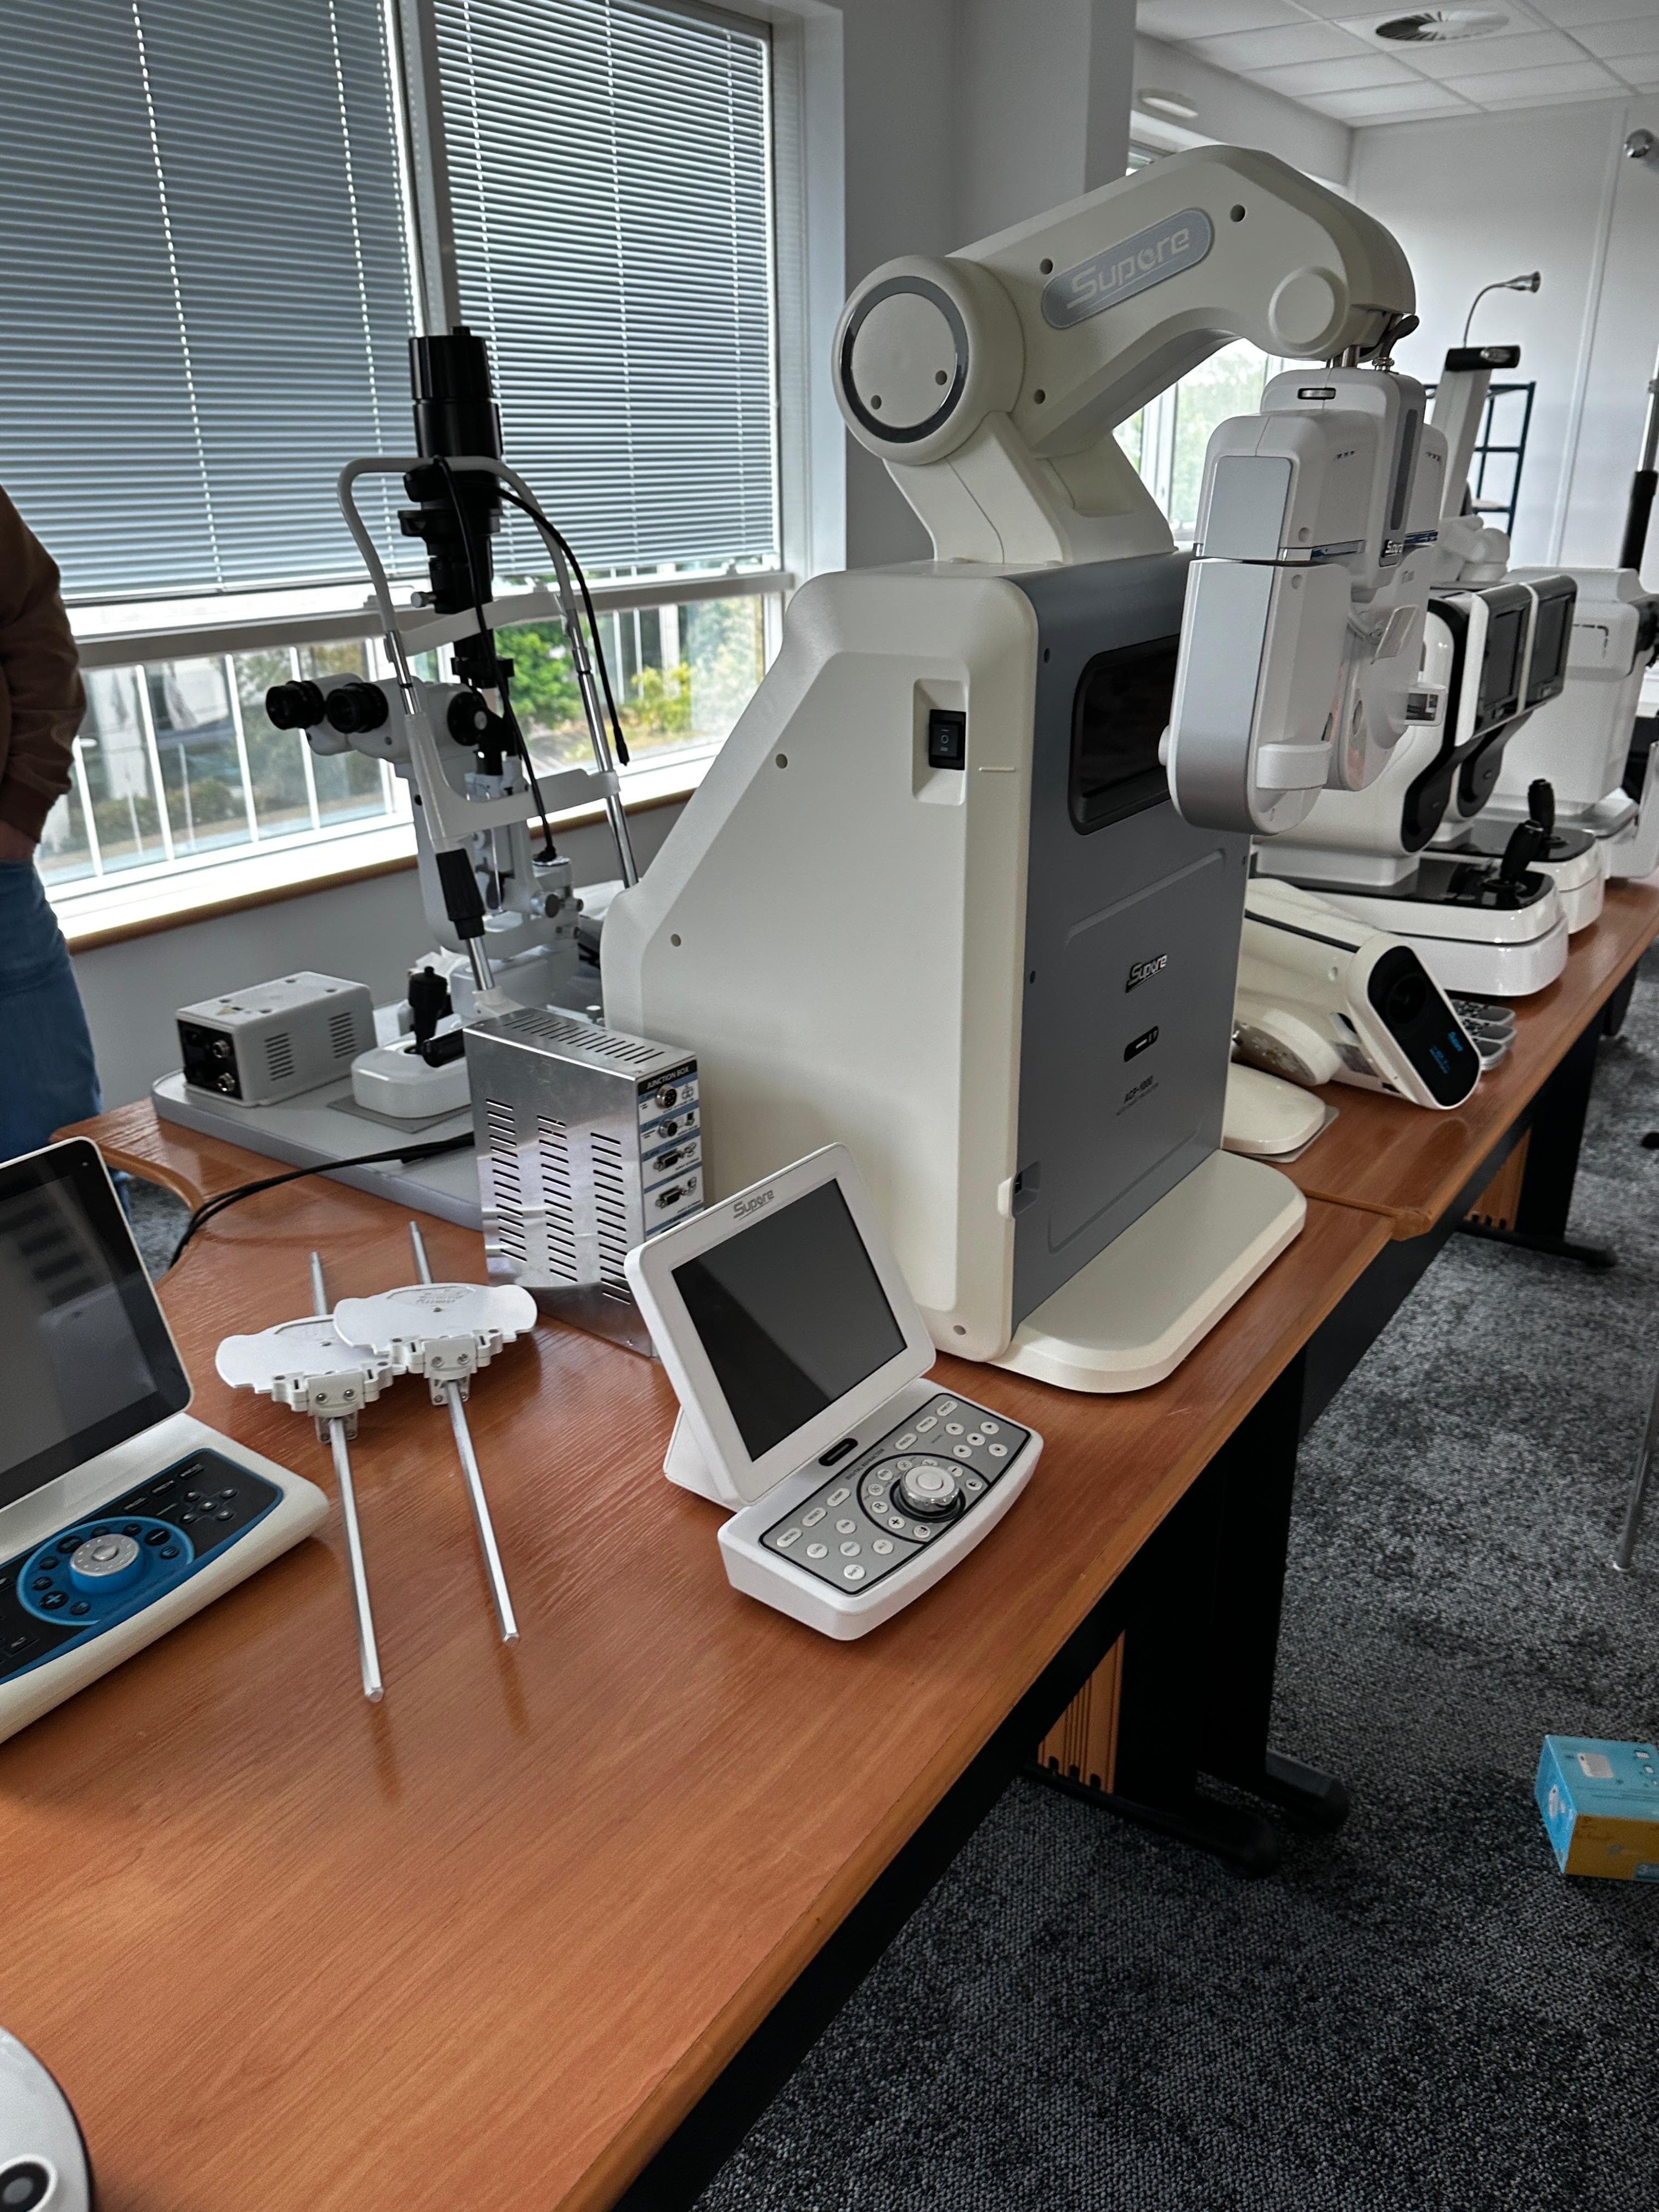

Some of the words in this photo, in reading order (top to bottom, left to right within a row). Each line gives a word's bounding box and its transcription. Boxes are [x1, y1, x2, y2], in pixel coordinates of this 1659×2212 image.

[1066, 228, 1189, 309] Supore
[1128, 955, 1167, 986] Supore
[646, 1071, 676, 1089] JUNCTION
[677, 1066, 689, 1076] BOX
[733, 1190, 774, 1218] Supore
